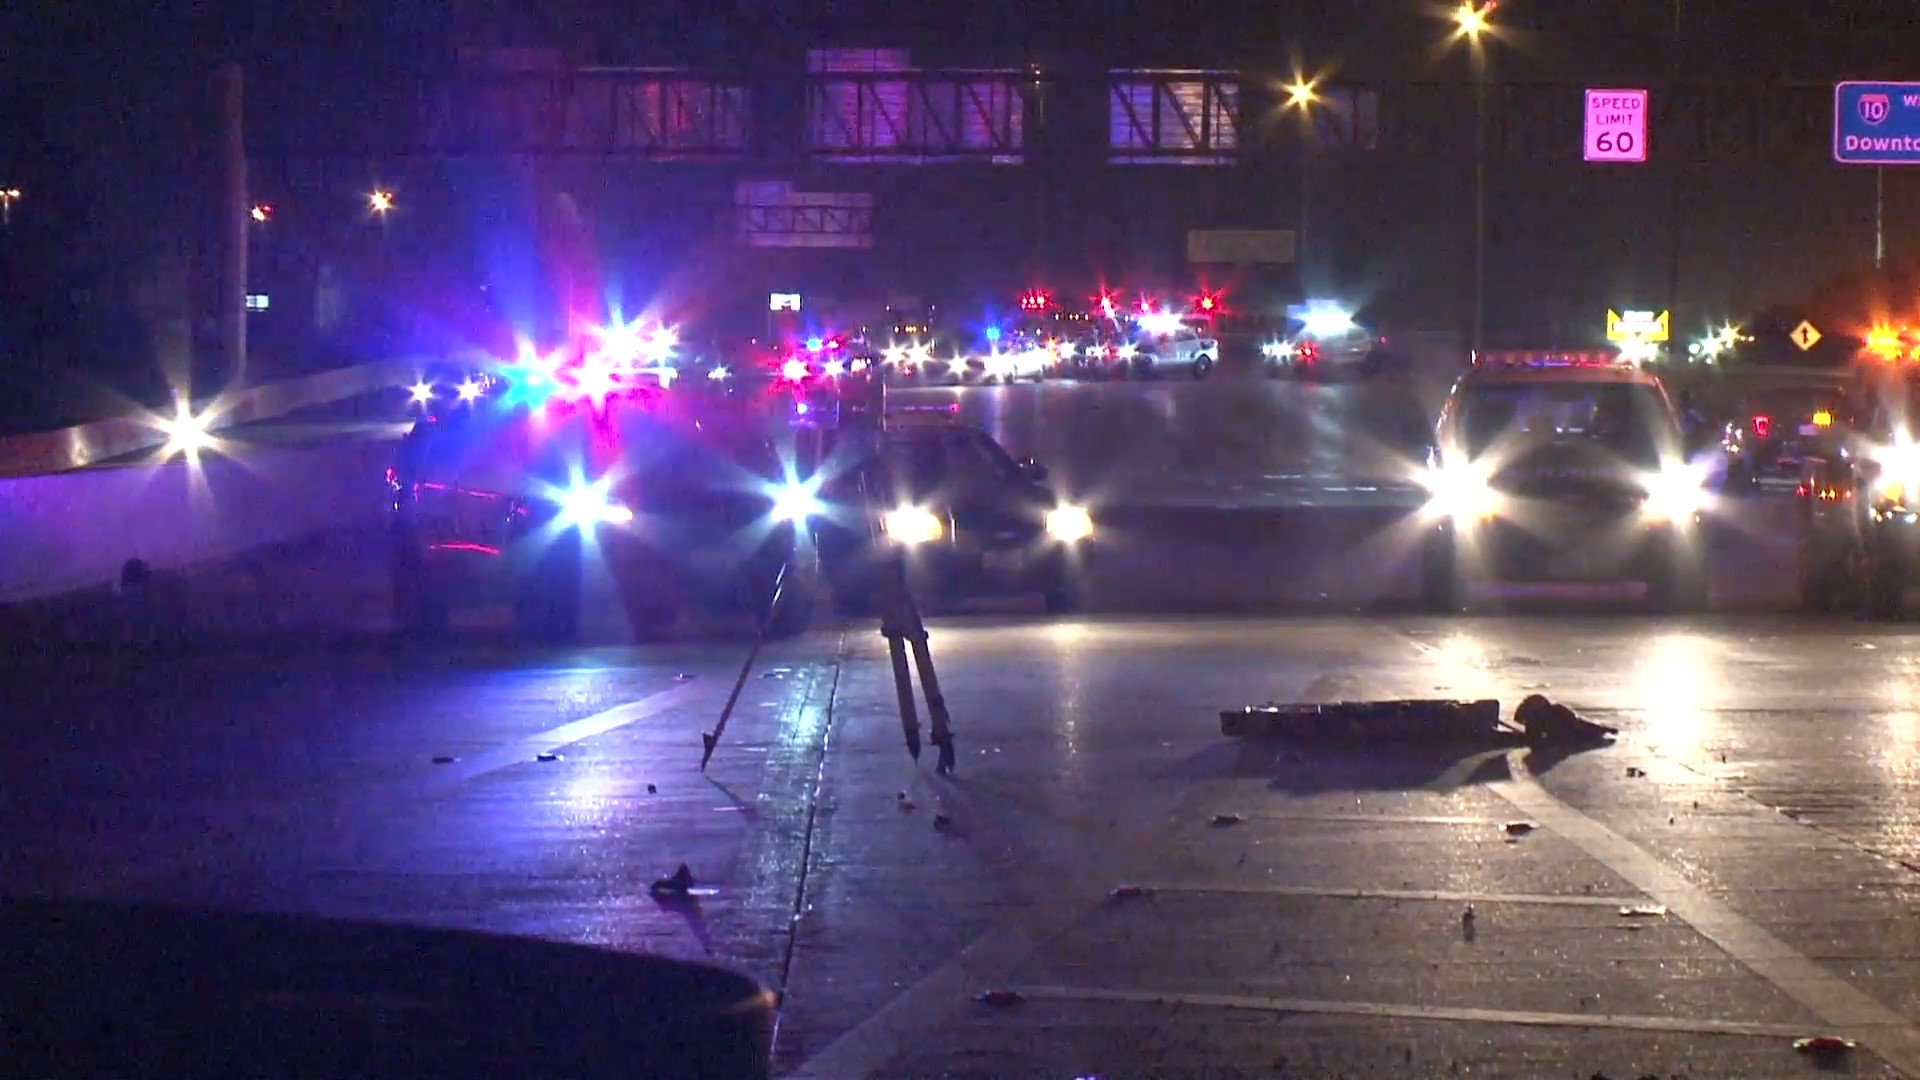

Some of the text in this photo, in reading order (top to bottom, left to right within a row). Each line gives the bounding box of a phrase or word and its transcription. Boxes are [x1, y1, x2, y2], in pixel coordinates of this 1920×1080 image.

[1592, 97, 1640, 109] SPEED
[1865, 95, 1920, 119] 10 W
[1596, 114, 1633, 125] LIMIT
[1596, 131, 1634, 153] 60
